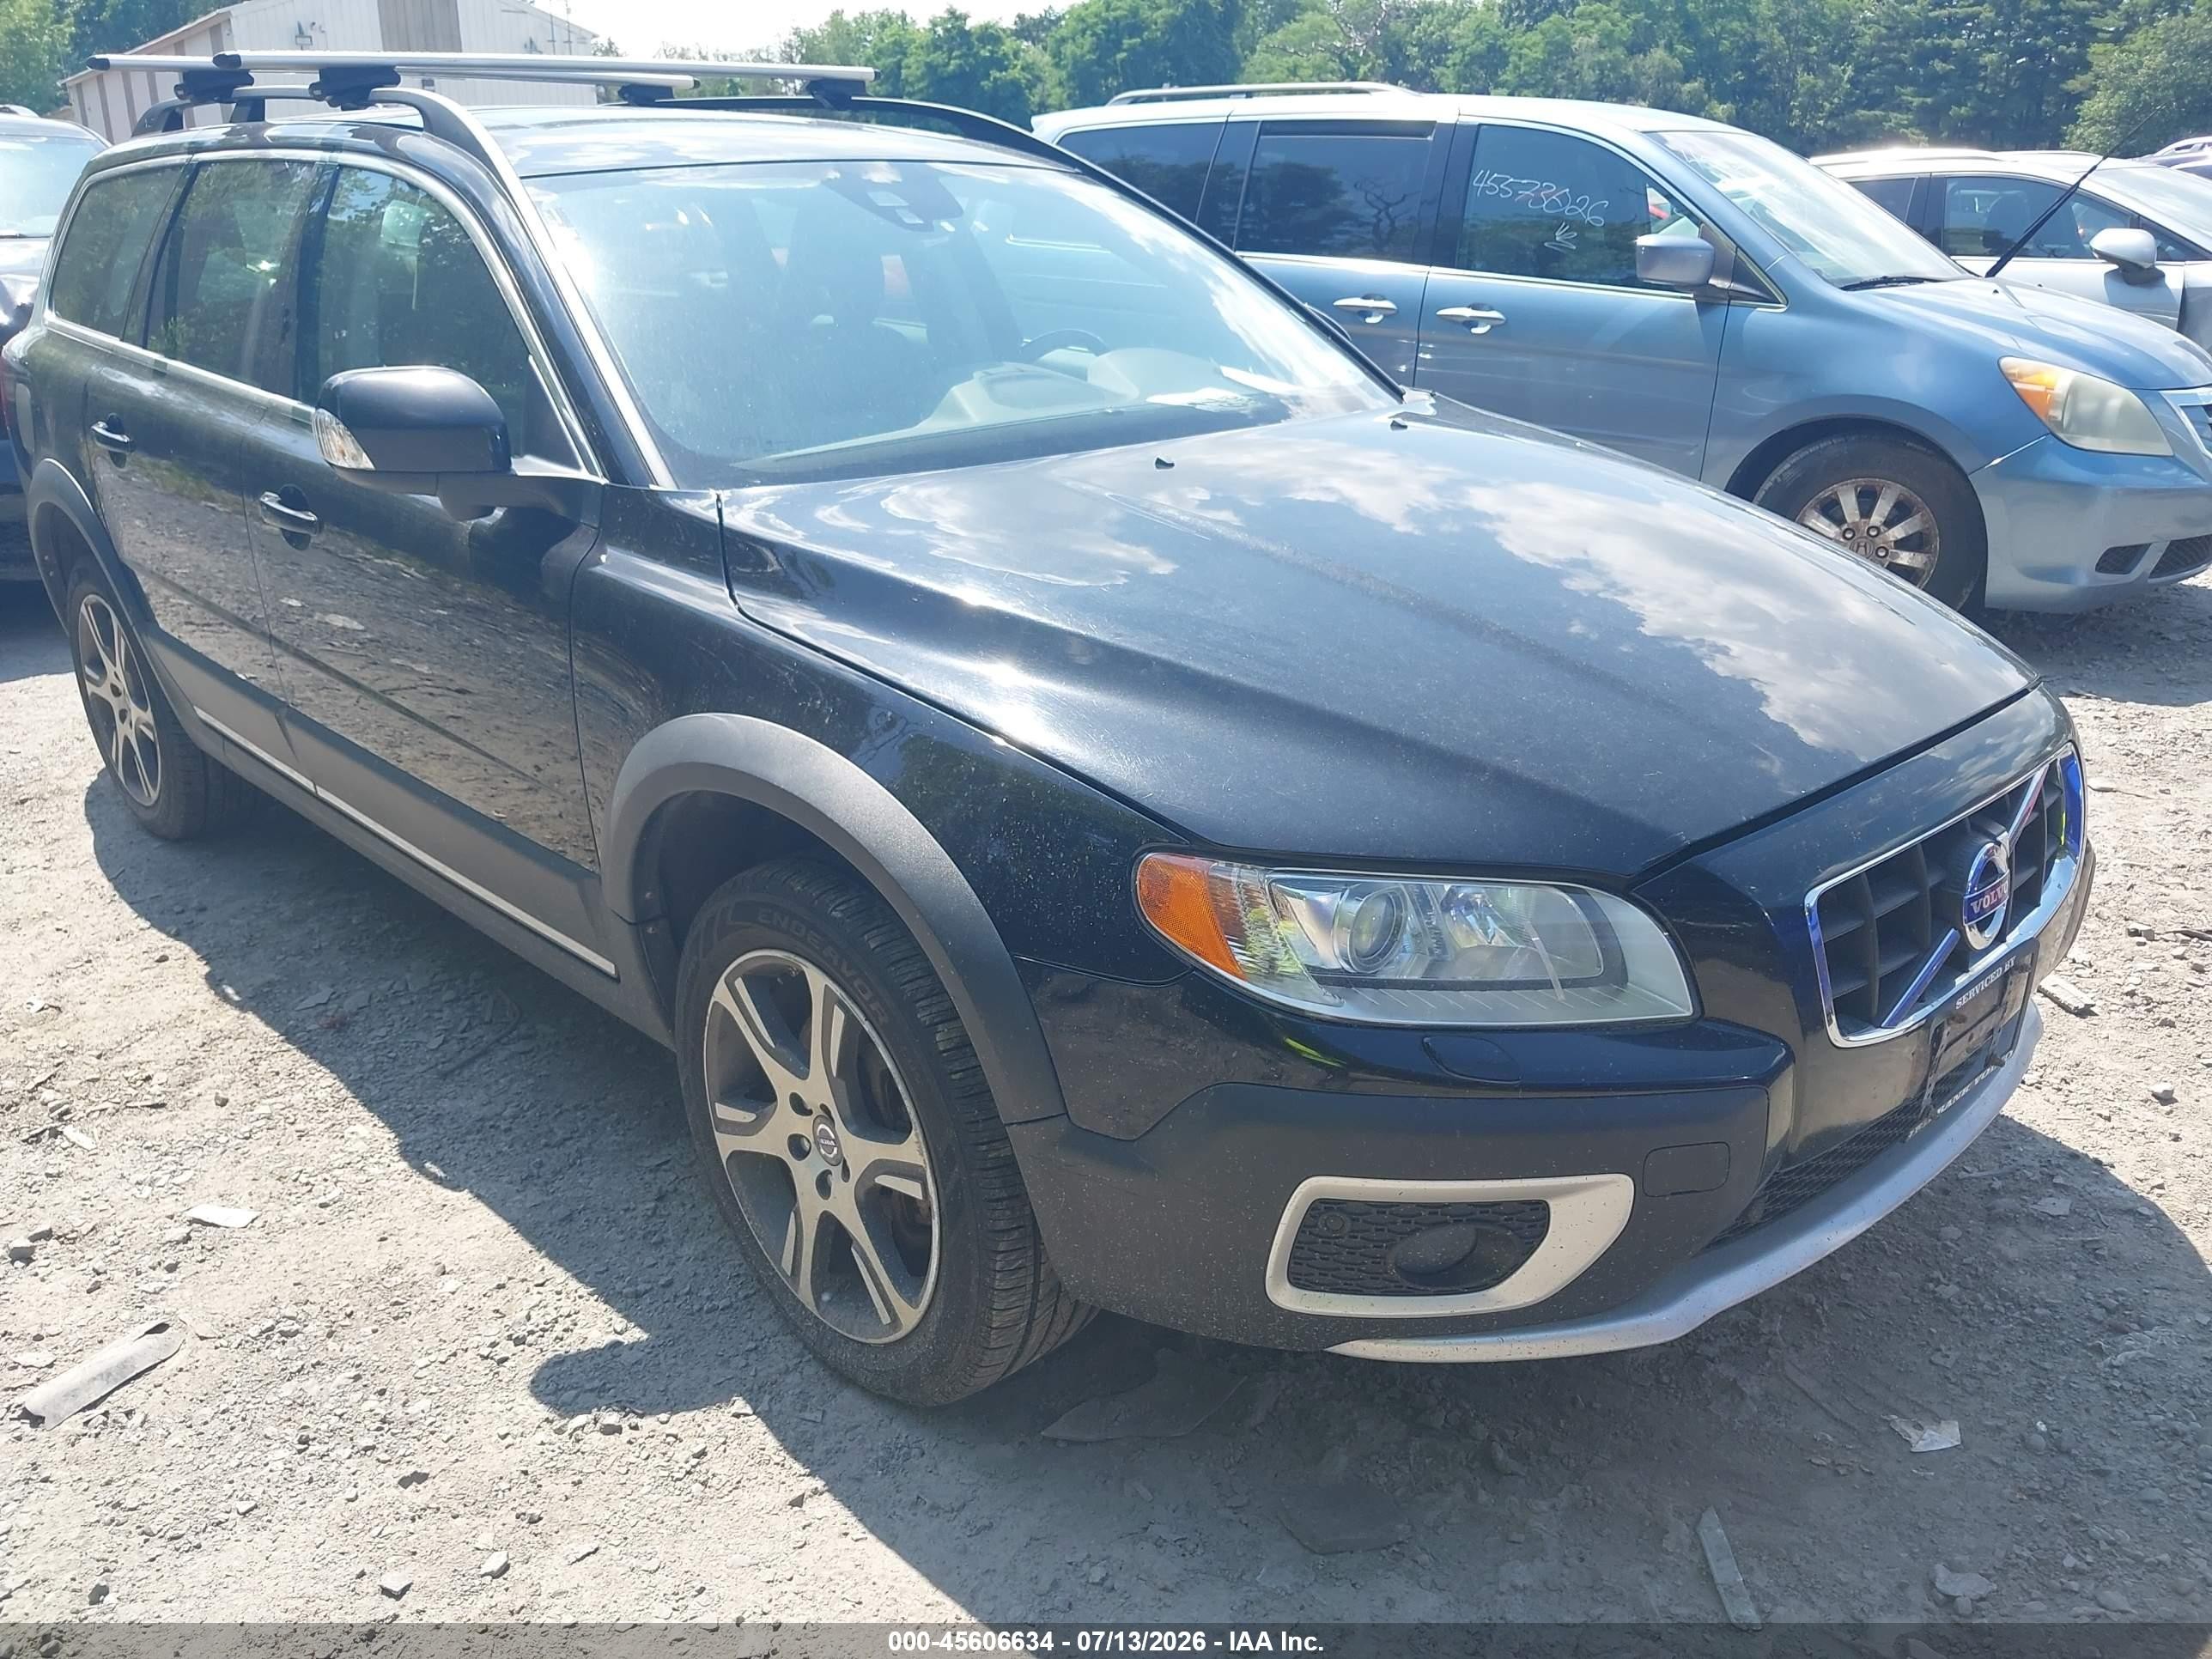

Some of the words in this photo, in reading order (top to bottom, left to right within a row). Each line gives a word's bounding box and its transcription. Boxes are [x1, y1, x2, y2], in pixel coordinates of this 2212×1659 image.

[1970, 879, 2009, 915] VOLVO
[1955, 967, 2002, 1010] SERVICED
[2003, 955, 2017, 974] BY
[1974, 1049, 2014, 1086] VOLO
